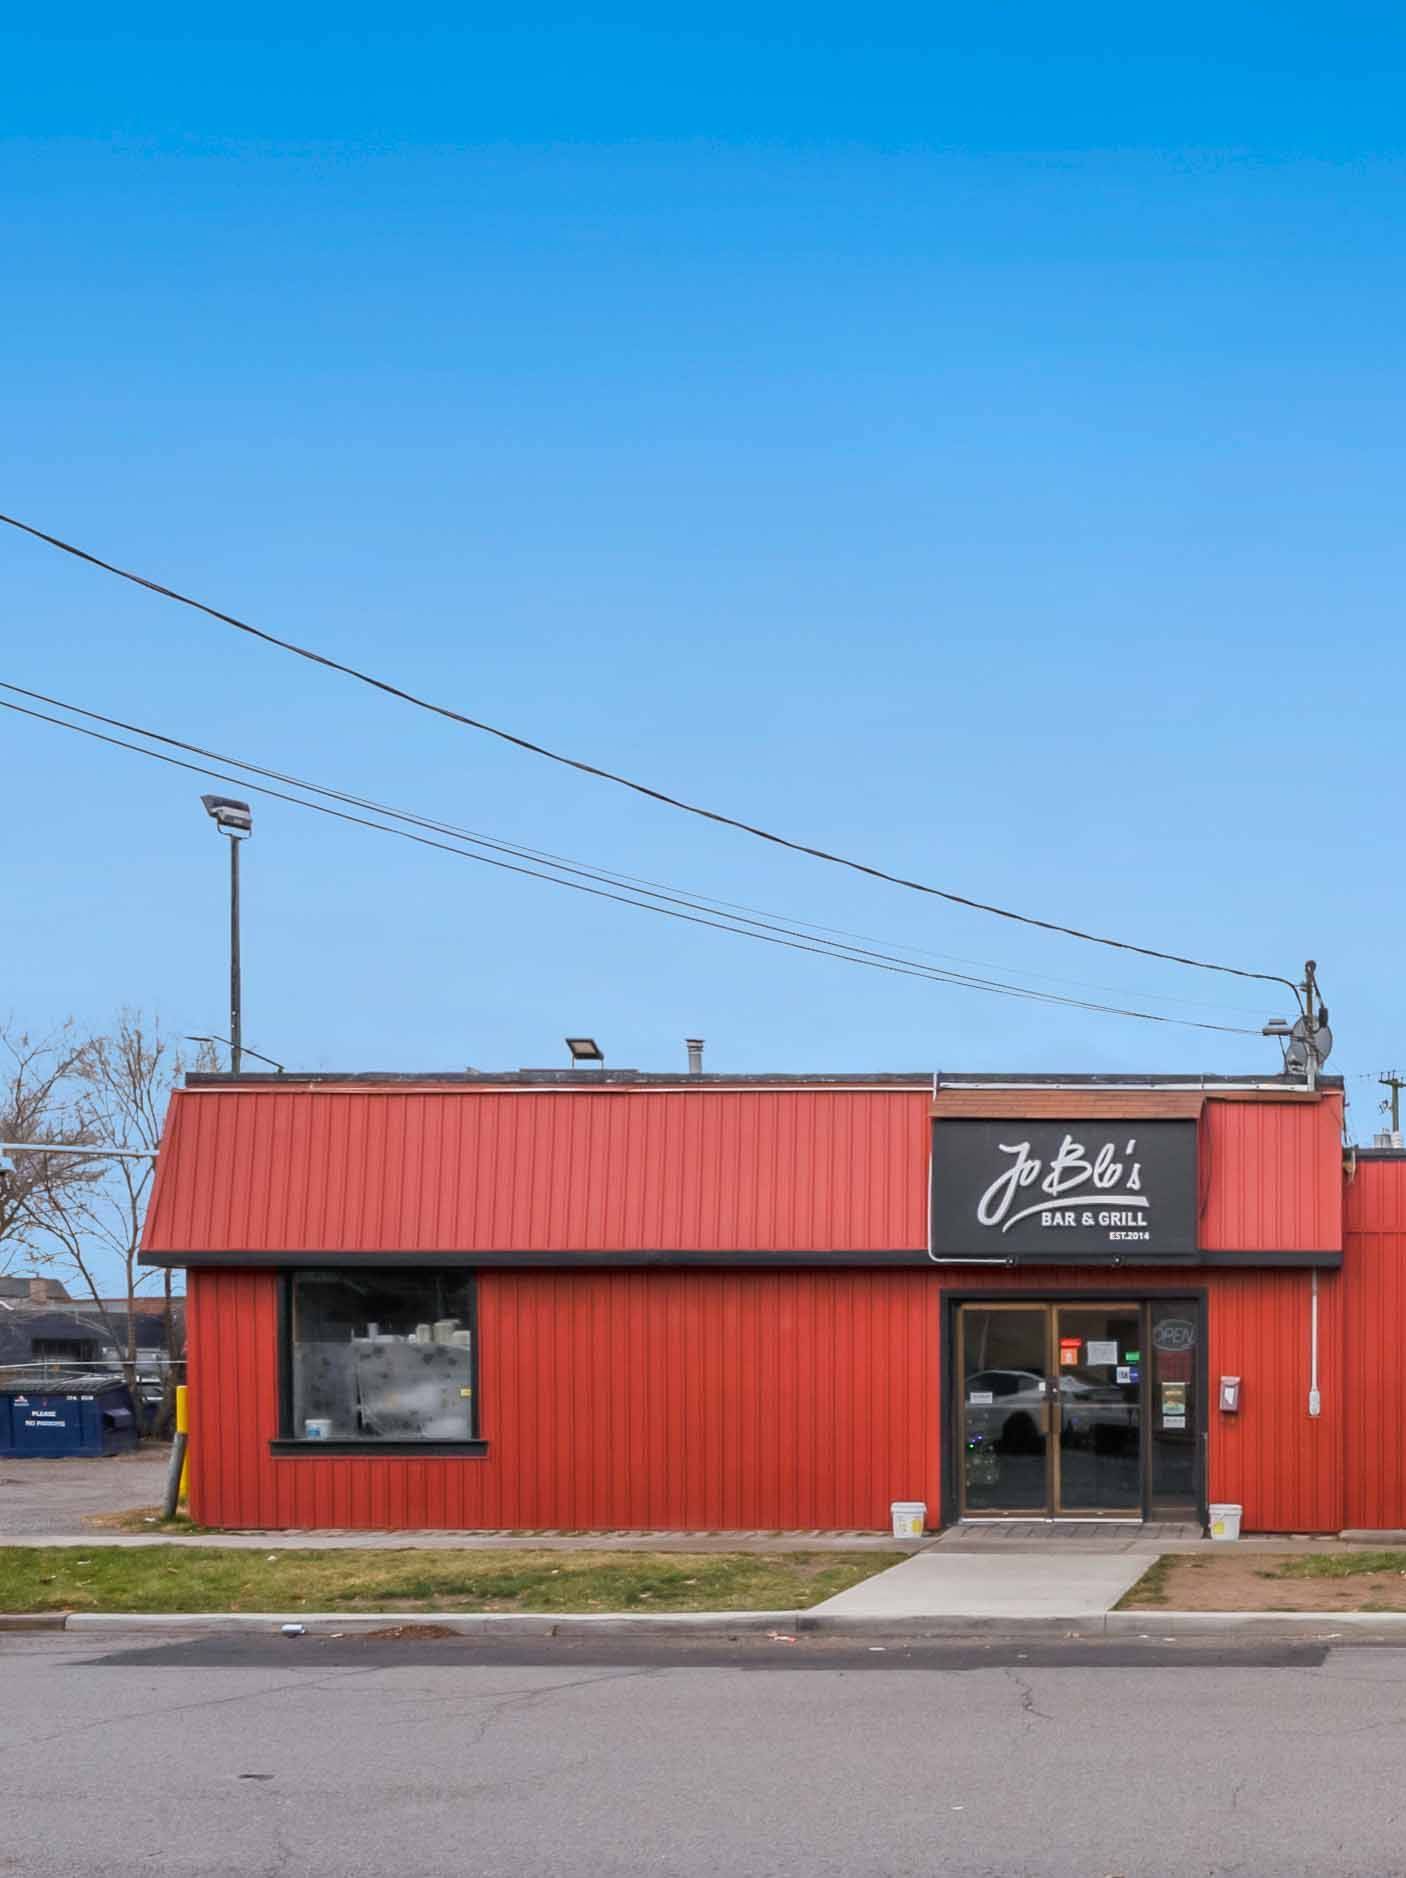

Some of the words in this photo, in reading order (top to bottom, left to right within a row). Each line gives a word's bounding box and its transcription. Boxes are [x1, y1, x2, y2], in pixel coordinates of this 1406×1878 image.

[977, 1141, 1042, 1226] Jo
[1041, 1134, 1142, 1197] Blo's
[1041, 1212, 1077, 1226] BAR
[1082, 1212, 1095, 1226] &
[1098, 1212, 1148, 1226] GRILL
[1109, 1231, 1150, 1241] EST.2014
[1156, 1327, 1196, 1345] OPEN
